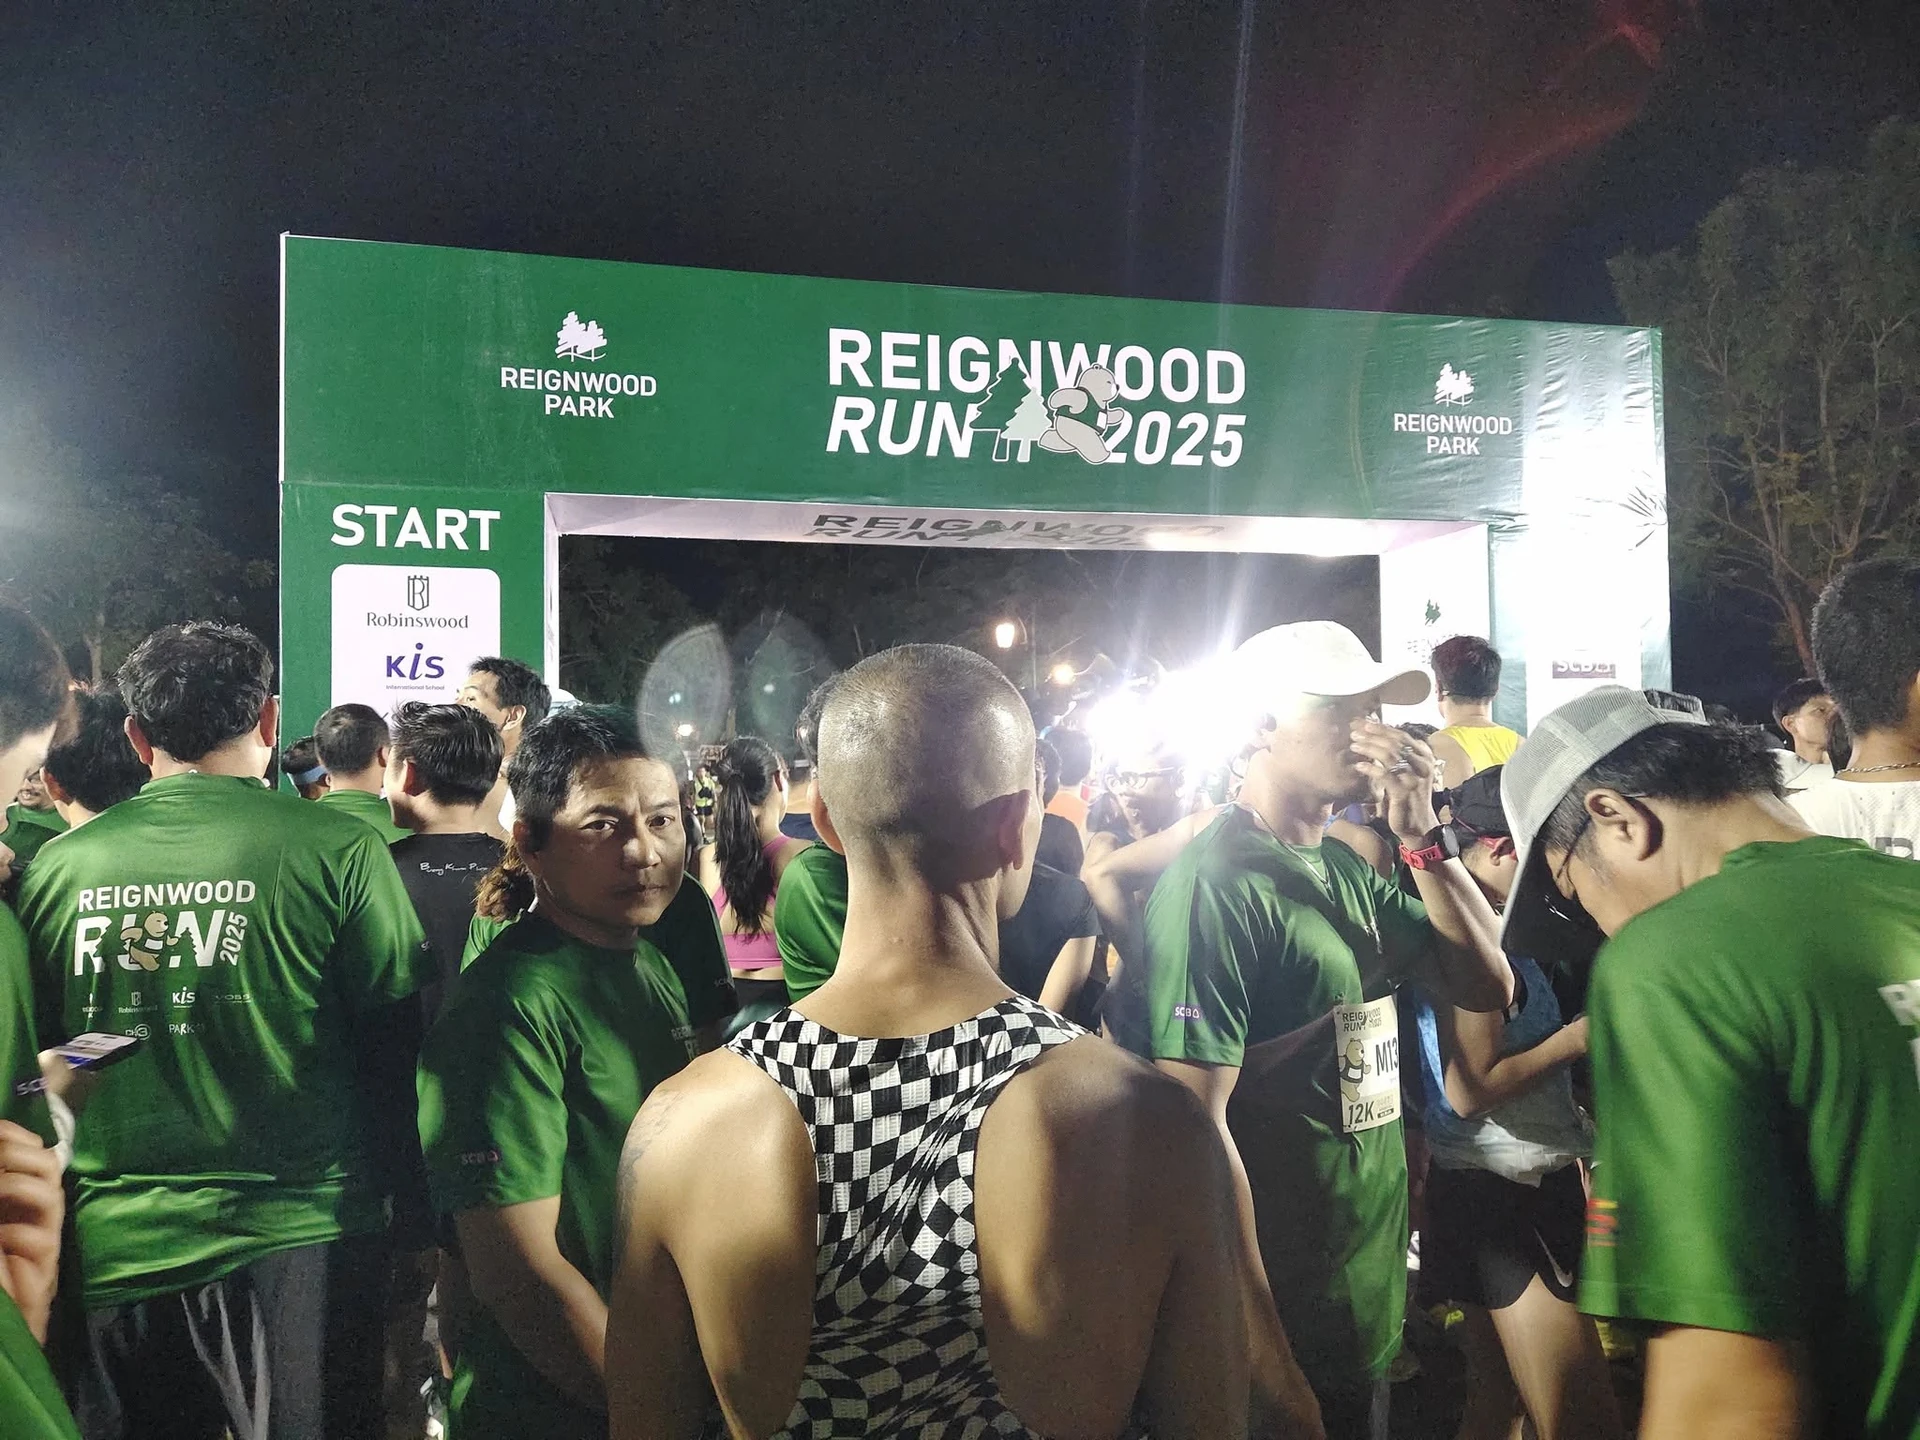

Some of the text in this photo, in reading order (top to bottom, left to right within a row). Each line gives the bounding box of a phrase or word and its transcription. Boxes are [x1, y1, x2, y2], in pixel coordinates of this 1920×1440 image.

[501, 366, 657, 398] REIGNWOOD
[828, 327, 1246, 405] REIGNWOOD
[545, 394, 614, 419] PARK
[826, 395, 1247, 468] RUN 2025
[1393, 412, 1513, 436] REIGNWOOD
[1426, 435, 1481, 456] PARK
[331, 503, 500, 552] START
[366, 611, 469, 629] Robinswood
[78, 880, 256, 913] REIGNWOOD
[219, 911, 249, 967] 2025
[1348, 1100, 1375, 1126] 12K
